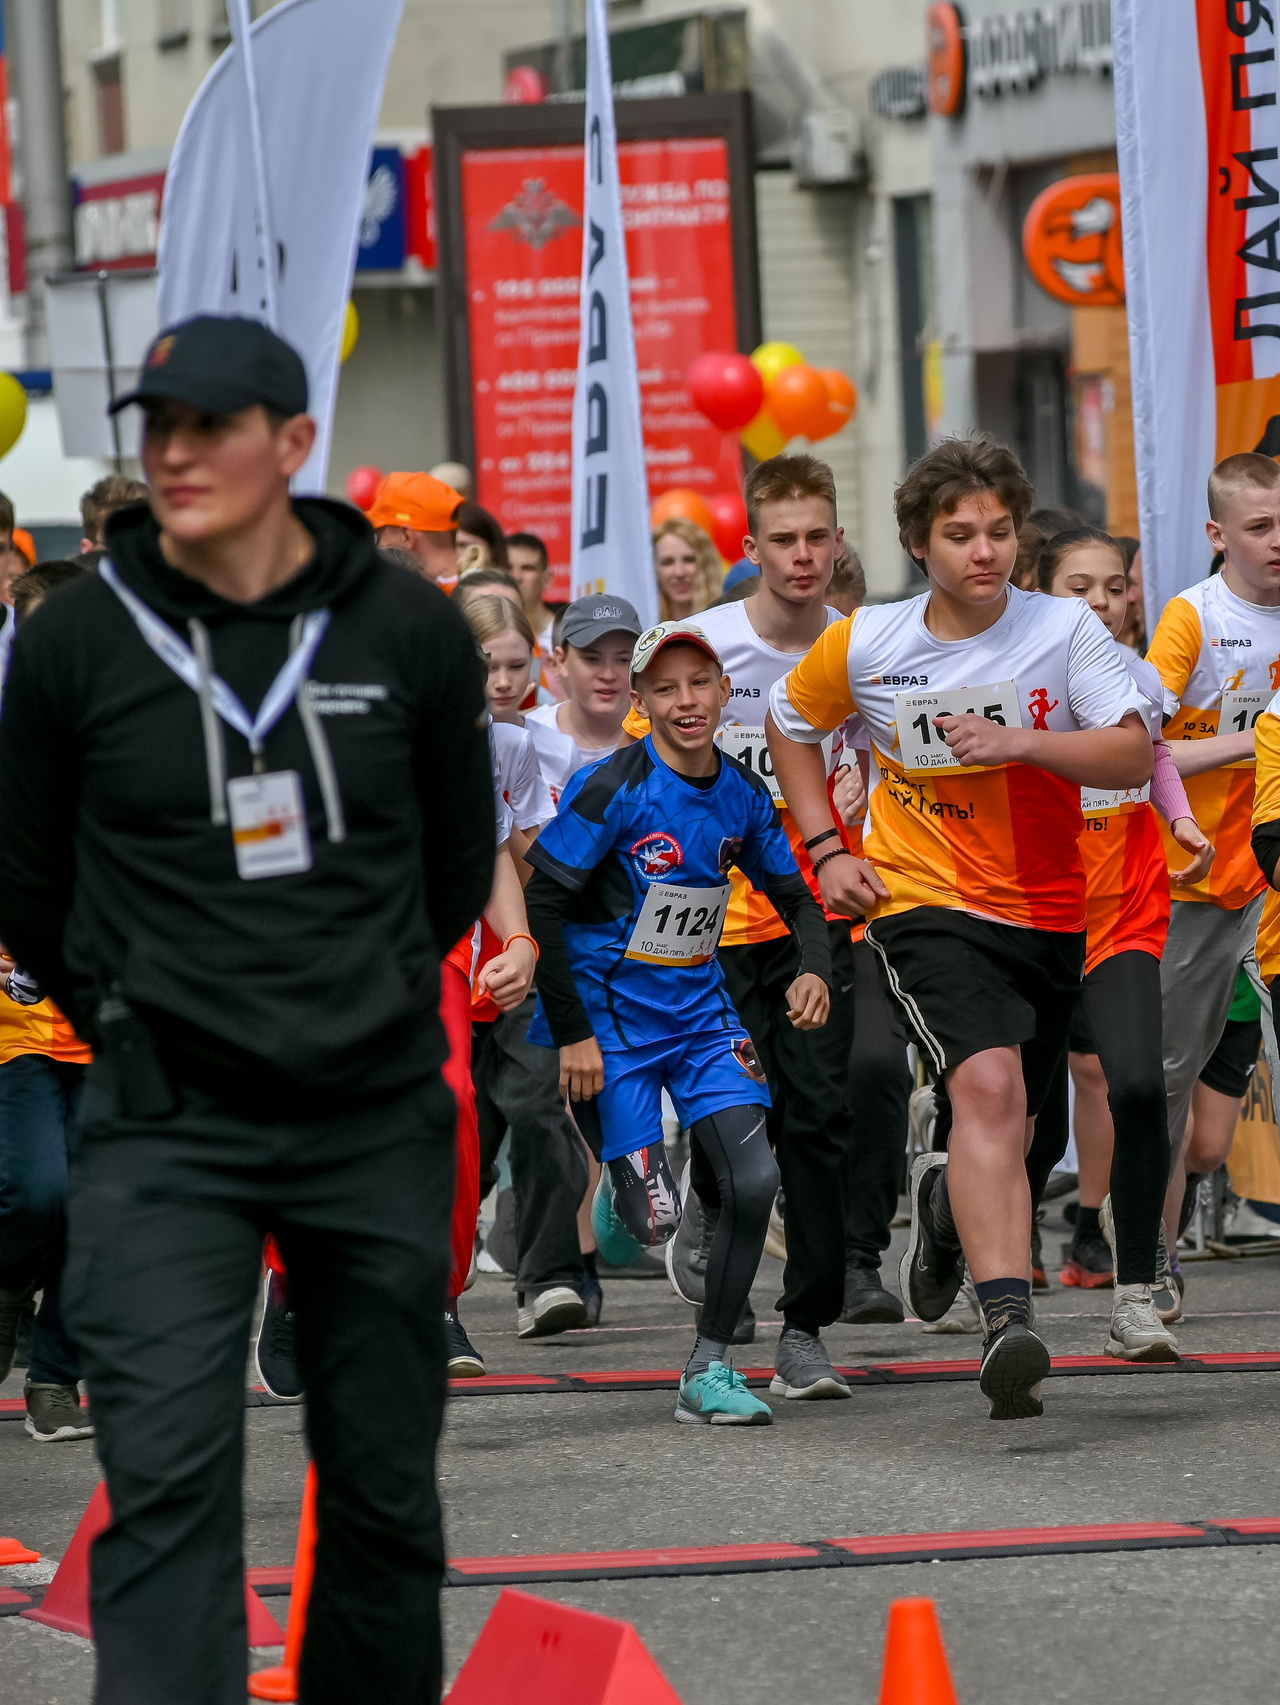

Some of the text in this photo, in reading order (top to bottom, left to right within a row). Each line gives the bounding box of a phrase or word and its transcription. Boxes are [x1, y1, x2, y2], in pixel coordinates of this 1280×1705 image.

[1220, 638, 1252, 648] ЕВРАЗ
[882, 675, 929, 686] ЕВРАЗ
[729, 688, 761, 698] ВРАЗ
[912, 698, 938, 707] ЕВРАЗ
[1183, 721, 1197, 731] 10
[914, 754, 961, 767] 10 ДАЙ ПЯ
[919, 797, 975, 819] ПЯТЬ!
[1082, 799, 1110, 809] АЙ ПЯТЬ
[1085, 816, 1108, 831] ТЬ!
[664, 891, 688, 900] ЕВРАЗ
[654, 904, 721, 937] 1124
[640, 940, 685, 957] 10 ДАЙ ПЯТЬ
